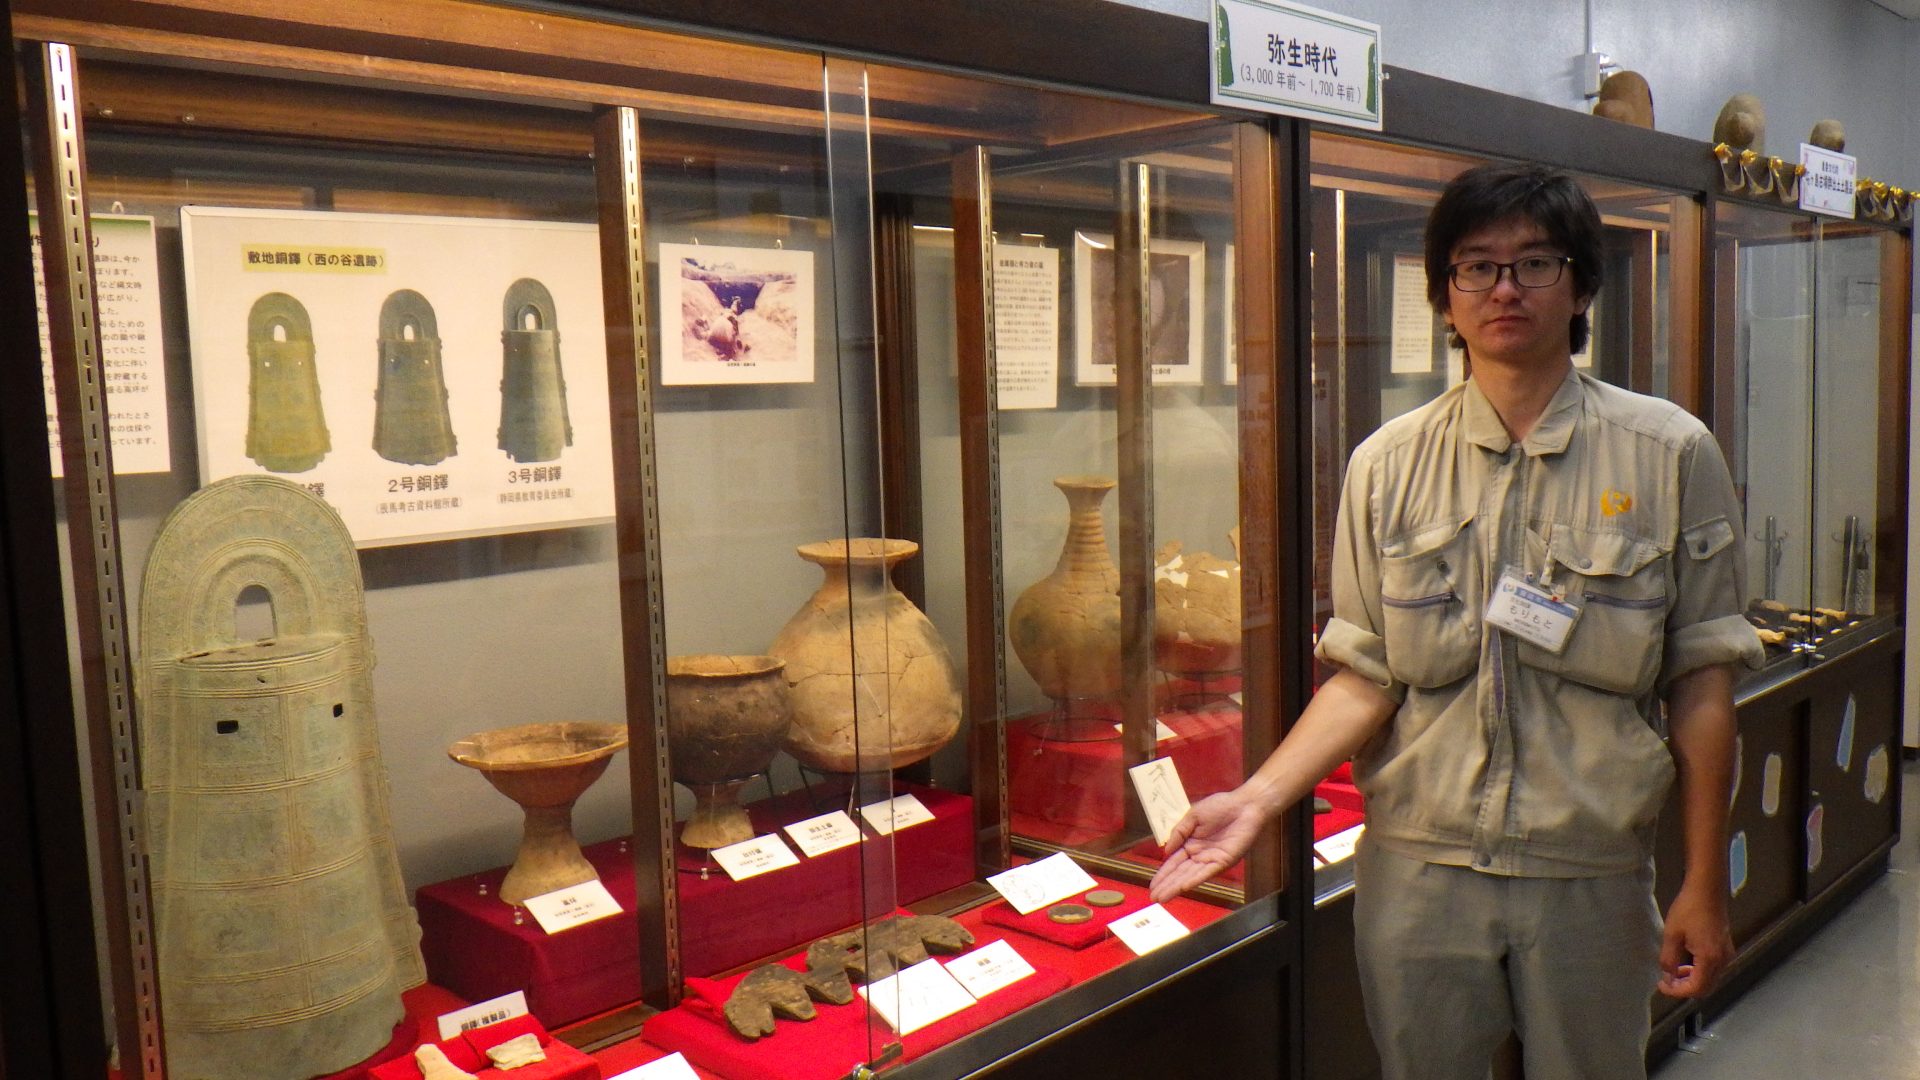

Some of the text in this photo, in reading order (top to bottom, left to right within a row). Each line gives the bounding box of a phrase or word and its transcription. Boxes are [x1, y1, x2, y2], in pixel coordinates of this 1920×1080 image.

[1267, 33, 1338, 77] 弥生時代
[388, 474, 449, 493] 2号銅鐸
[508, 466, 562, 484] 3号銅鐸
[1510, 605, 1553, 630] もりもと
